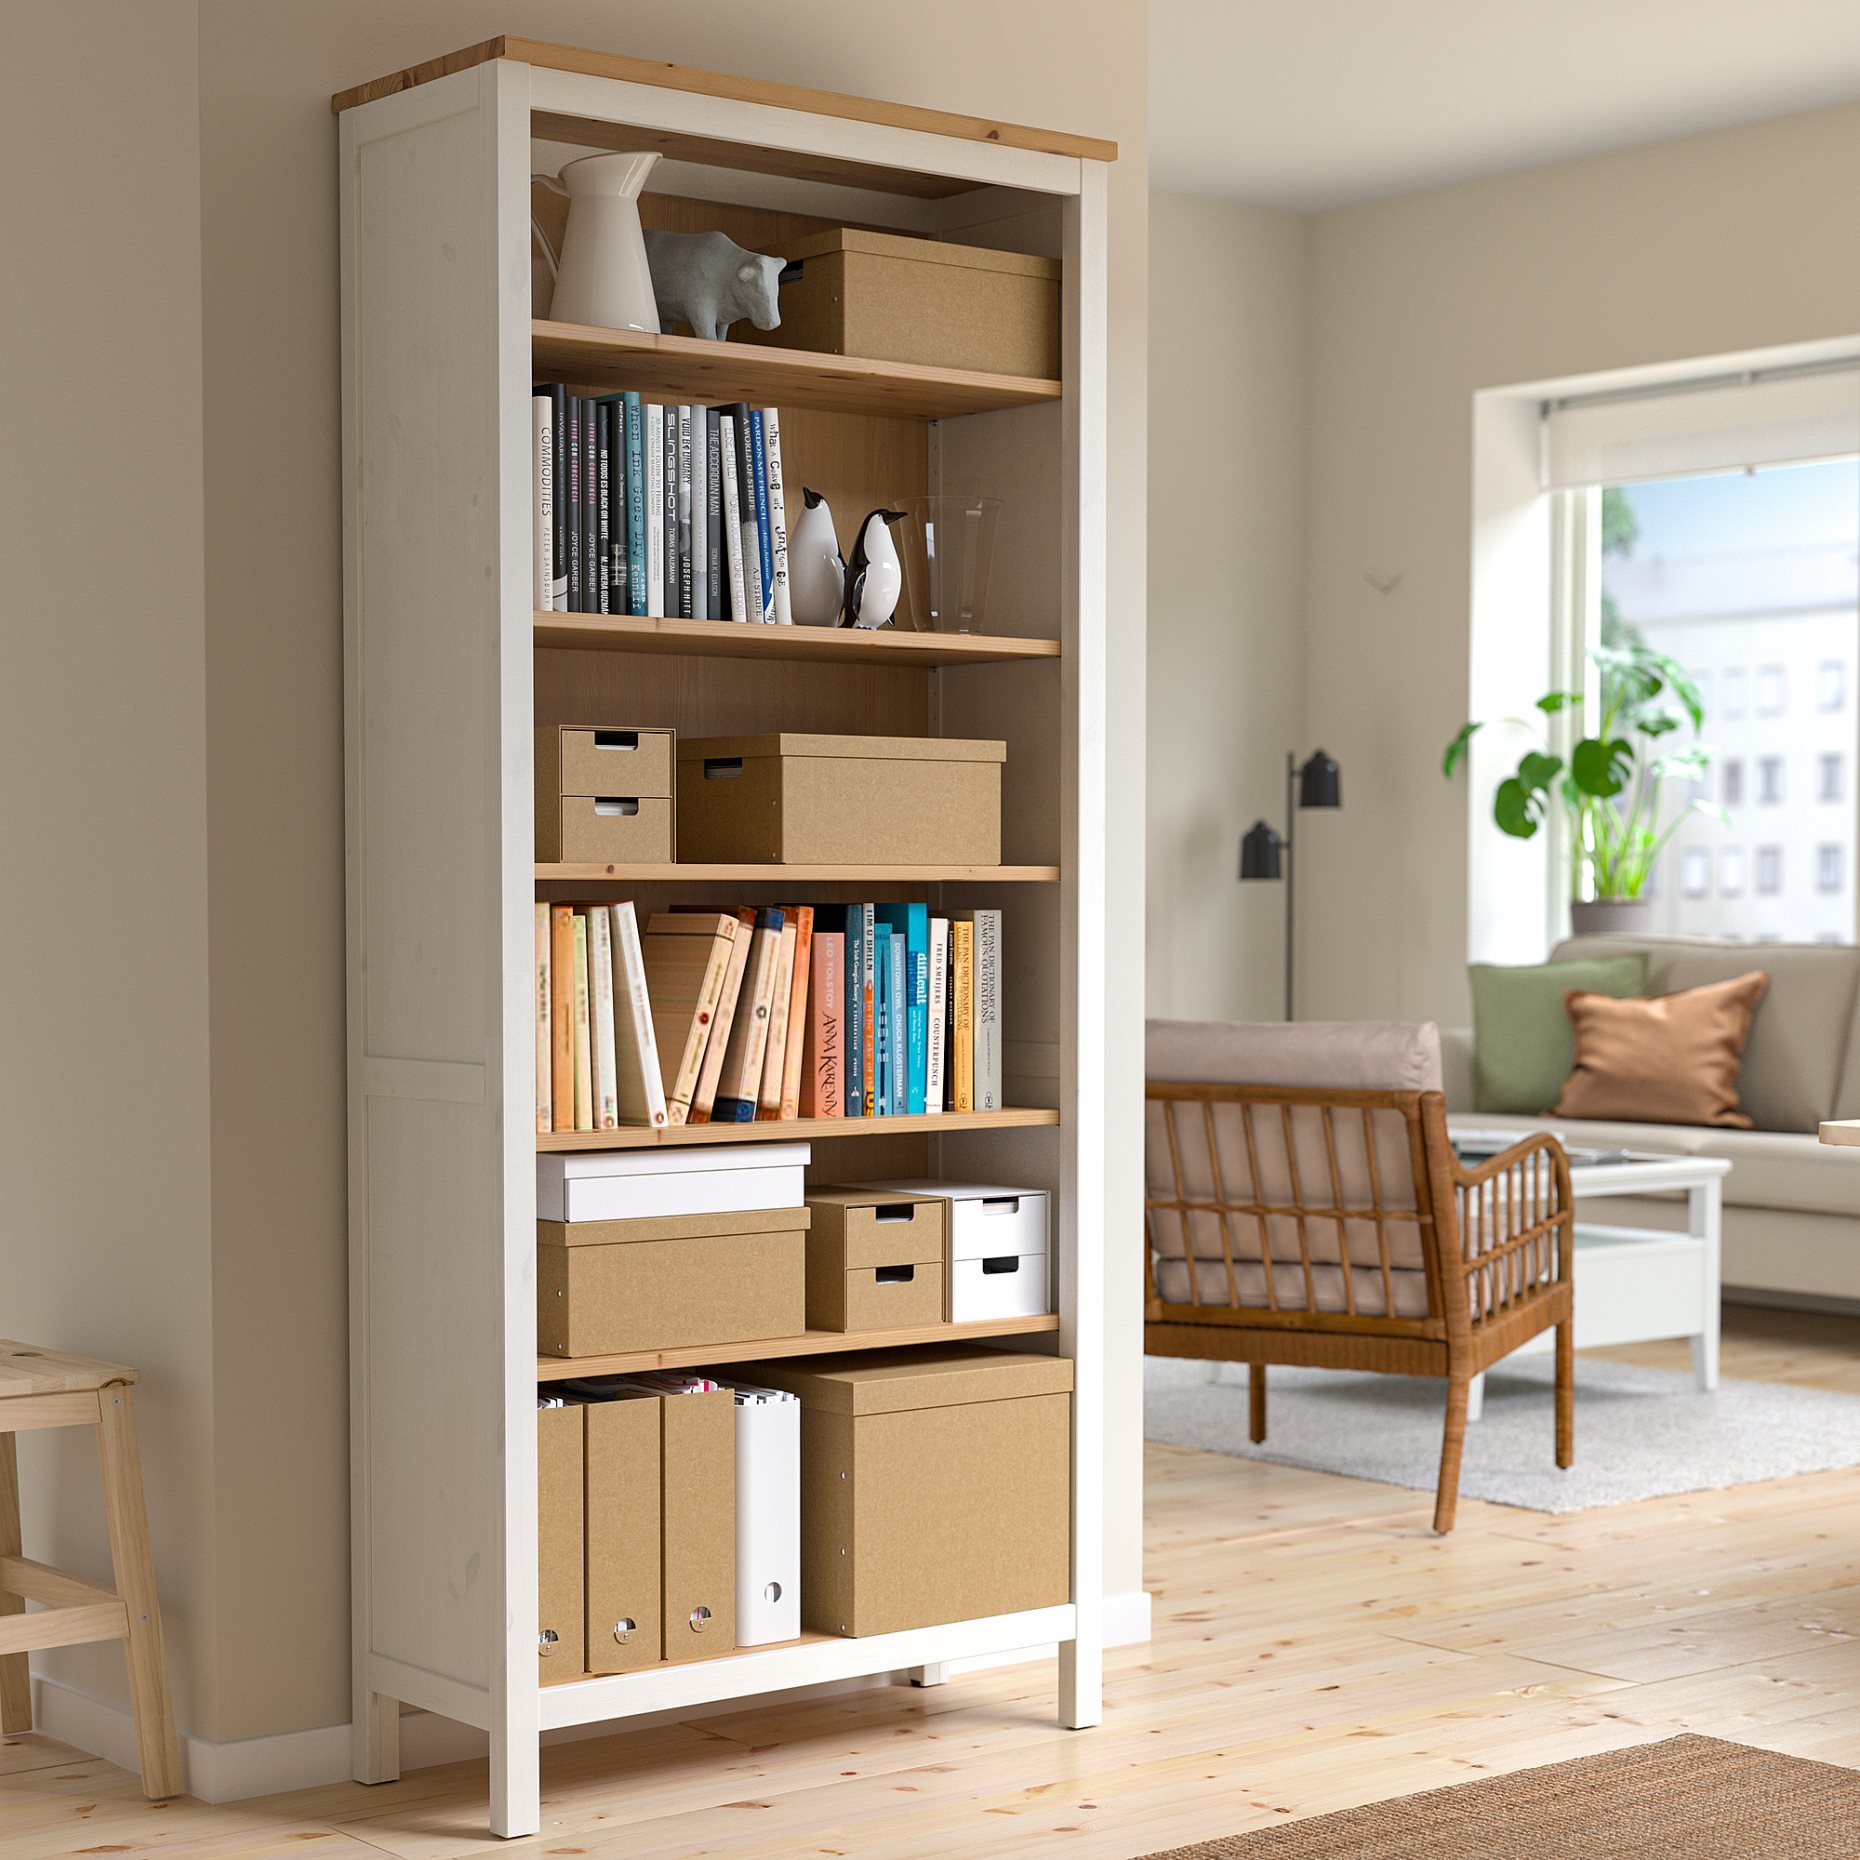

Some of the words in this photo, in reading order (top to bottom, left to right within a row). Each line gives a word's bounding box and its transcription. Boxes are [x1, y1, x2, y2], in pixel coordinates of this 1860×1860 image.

[631, 404, 641, 441] When
[709, 429, 719, 444] THE
[725, 428, 734, 449] ELISE
[744, 428, 753, 462] WORLD
[754, 416, 763, 459] PARDON
[600, 449, 608, 459] NO
[632, 450, 641, 477] Ink
[542, 427, 551, 517] COMMODITIES
[600, 460, 608, 480] TODOS
[746, 464, 754, 478] OF
[757, 461, 764, 480] MY
[588, 463, 596, 505] CONCIENCIA
[600, 481, 608, 489] ES
[655, 479, 661, 488] TO
[747, 479, 756, 511] STRIFE
[600, 490, 608, 510] BLACK
[633, 486, 643, 523] Goes
[709, 495, 719, 516] MAN
[759, 480, 767, 520] FRENCH
[600, 510, 608, 519] OR
[600, 520, 608, 540] WHITE
[571, 531, 579, 557] JOYCE
[588, 533, 596, 559] JOYCE
[632, 531, 643, 559] Dry
[571, 560, 579, 592] GARBER
[588, 561, 596, 593] GARBER
[600, 565, 608, 590] JAVIERA
[683, 556, 691, 592] JOSEPH
[735, 558, 743, 579] Make
[683, 594, 691, 614] HITT
[754, 585, 762, 617] STRIFE
[826, 937, 834, 958] LEO
[894, 942, 902, 990] DOWNTOWN
[916, 953, 927, 1005] difficult
[826, 961, 834, 1009] TOLSTOY
[934, 966, 943, 1004] SMEIJERS
[962, 1019, 969, 1031] OF
[988, 1011, 995, 1023] OF
[822, 1011, 838, 1053] ANNA
[931, 1018, 941, 1086] COUNTERPUNCH
